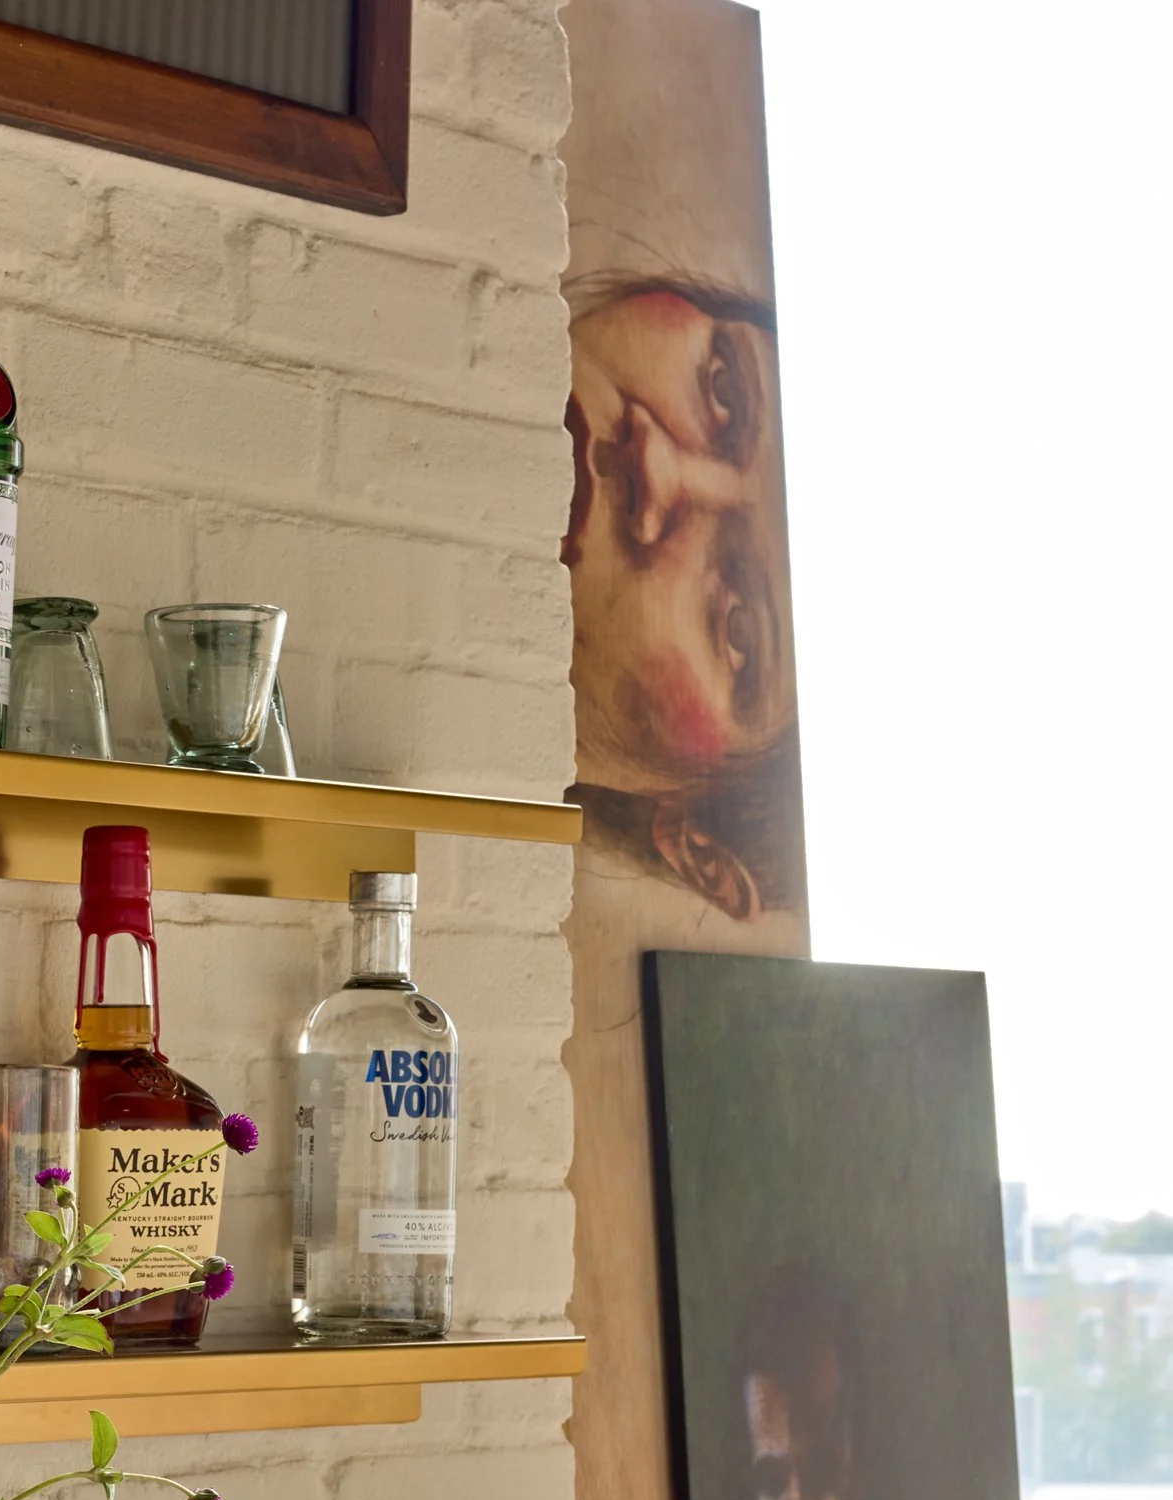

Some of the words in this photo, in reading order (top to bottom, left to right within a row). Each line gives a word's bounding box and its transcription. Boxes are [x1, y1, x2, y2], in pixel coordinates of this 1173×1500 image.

[369, 1120, 439, 1143] Swedish
[107, 1147, 221, 1174] Maker's
[141, 1181, 218, 1208] Mark
[187, 1214, 214, 1222] BOURBON
[404, 1221, 427, 1232] 40%
[129, 1224, 203, 1238] WHISKY
